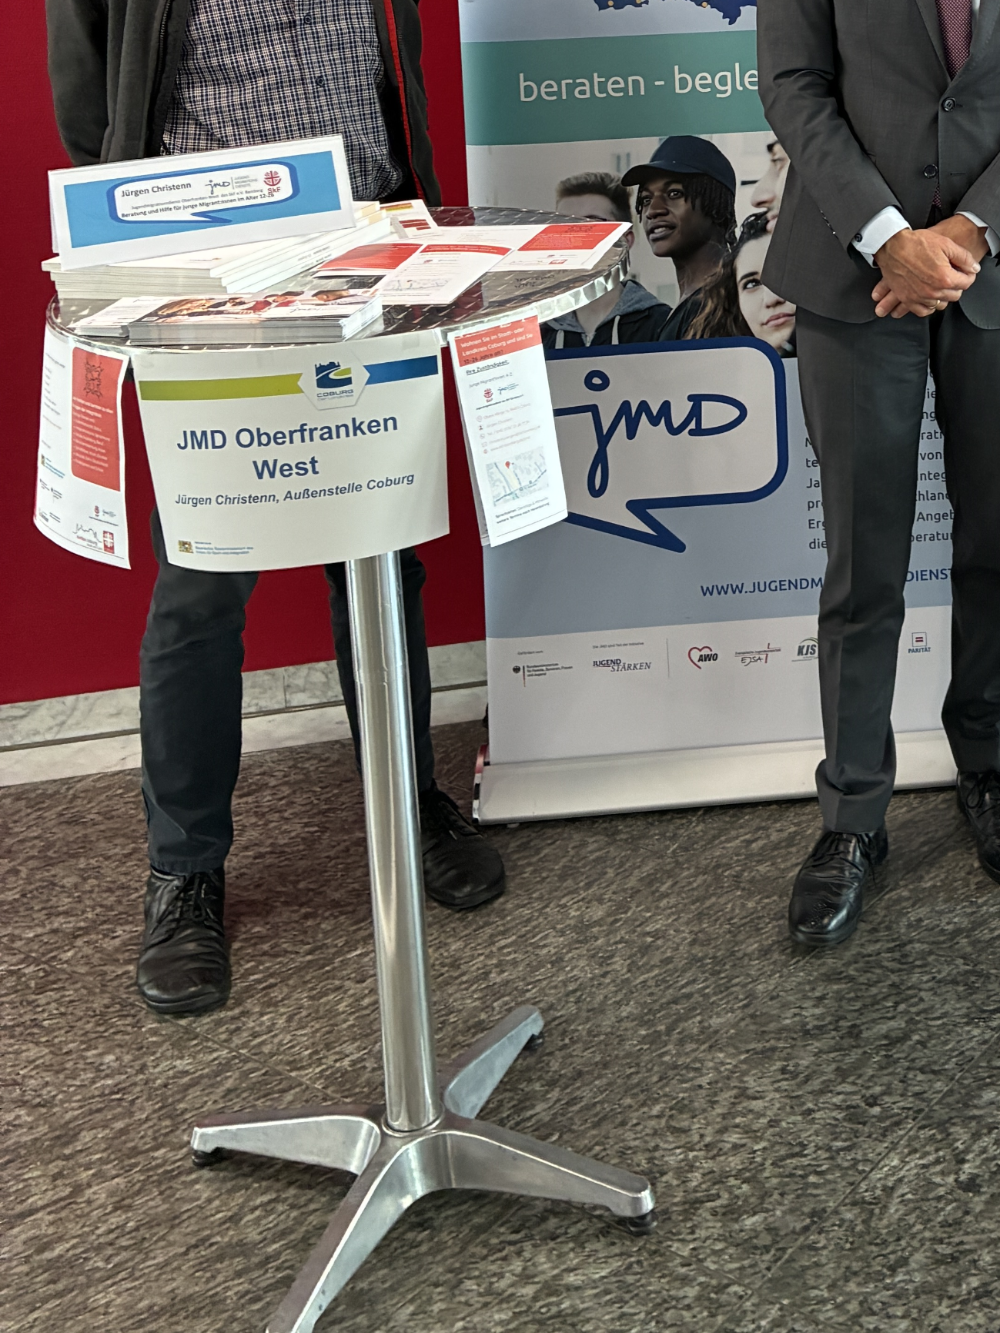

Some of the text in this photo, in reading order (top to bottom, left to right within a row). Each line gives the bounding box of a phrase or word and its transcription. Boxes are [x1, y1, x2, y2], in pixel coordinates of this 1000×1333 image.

[519, 72, 645, 101] beraten
[121, 182, 191, 198] Jürgen Christenn
[316, 389, 354, 397] COBURG
[177, 416, 398, 450] JMD Oberfranken
[253, 456, 319, 480] West
[175, 473, 415, 507] Jürgen Christenn, Außenstelle Coburg
[698, 652, 718, 662] AWO
[797, 644, 817, 656] KJS
[610, 662, 651, 672] STÄRKEN
